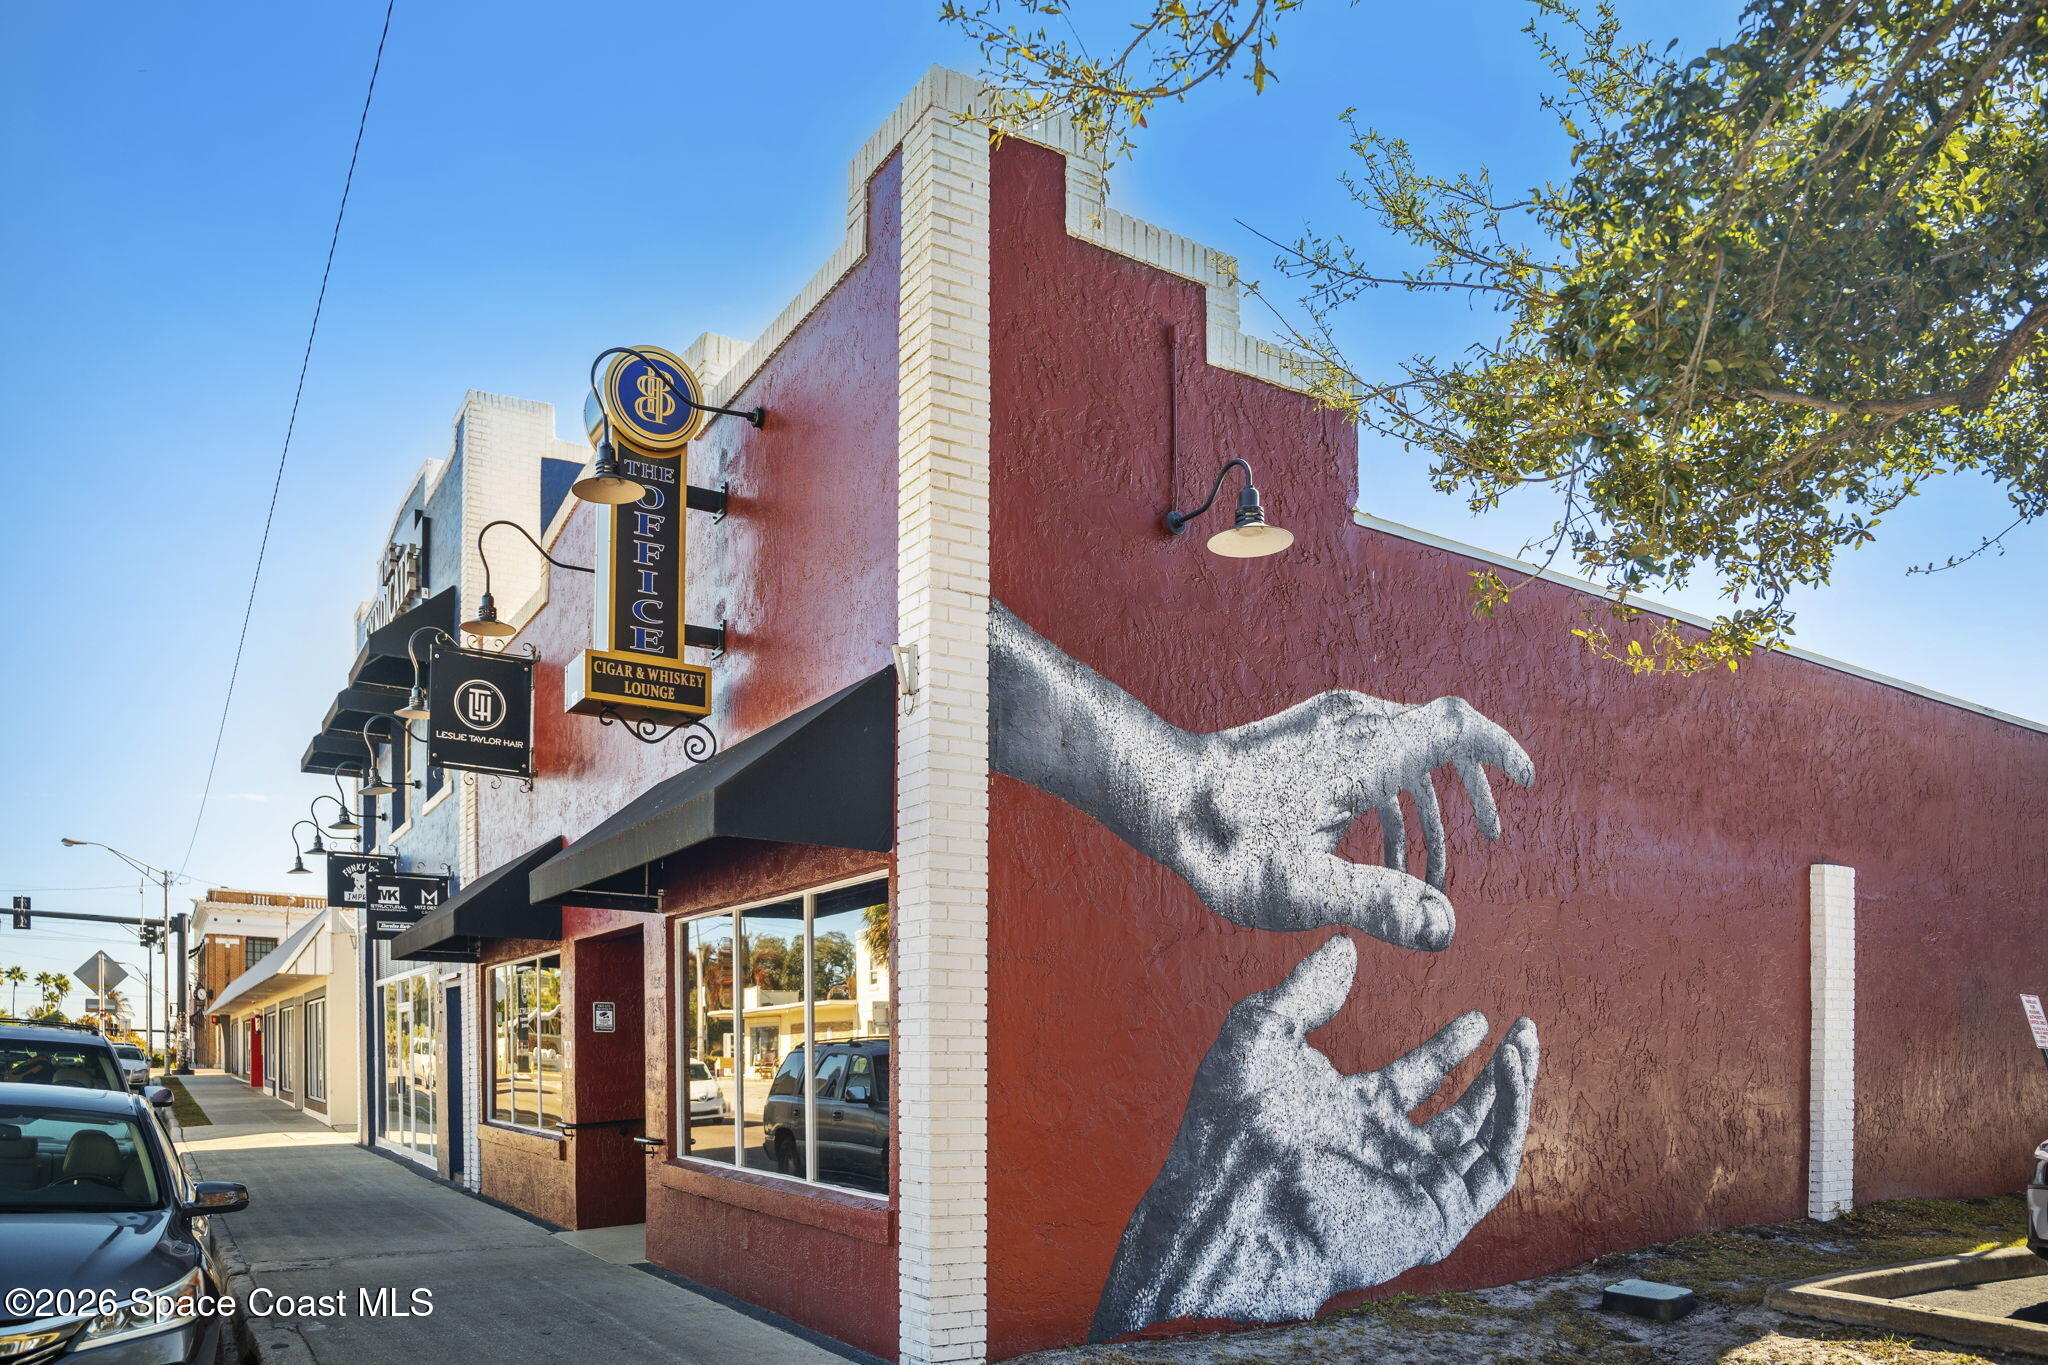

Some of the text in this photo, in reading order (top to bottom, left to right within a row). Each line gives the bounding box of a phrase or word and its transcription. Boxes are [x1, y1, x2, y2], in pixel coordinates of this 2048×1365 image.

[624, 459, 675, 484] THE
[630, 485, 666, 654] OFFICE
[593, 660, 704, 688] CIGAR & WHISKEY
[624, 681, 675, 700] LOUNGE
[436, 730, 524, 748] LESLIE TAYLOR HAIR
[342, 863, 366, 877] FUNKY
